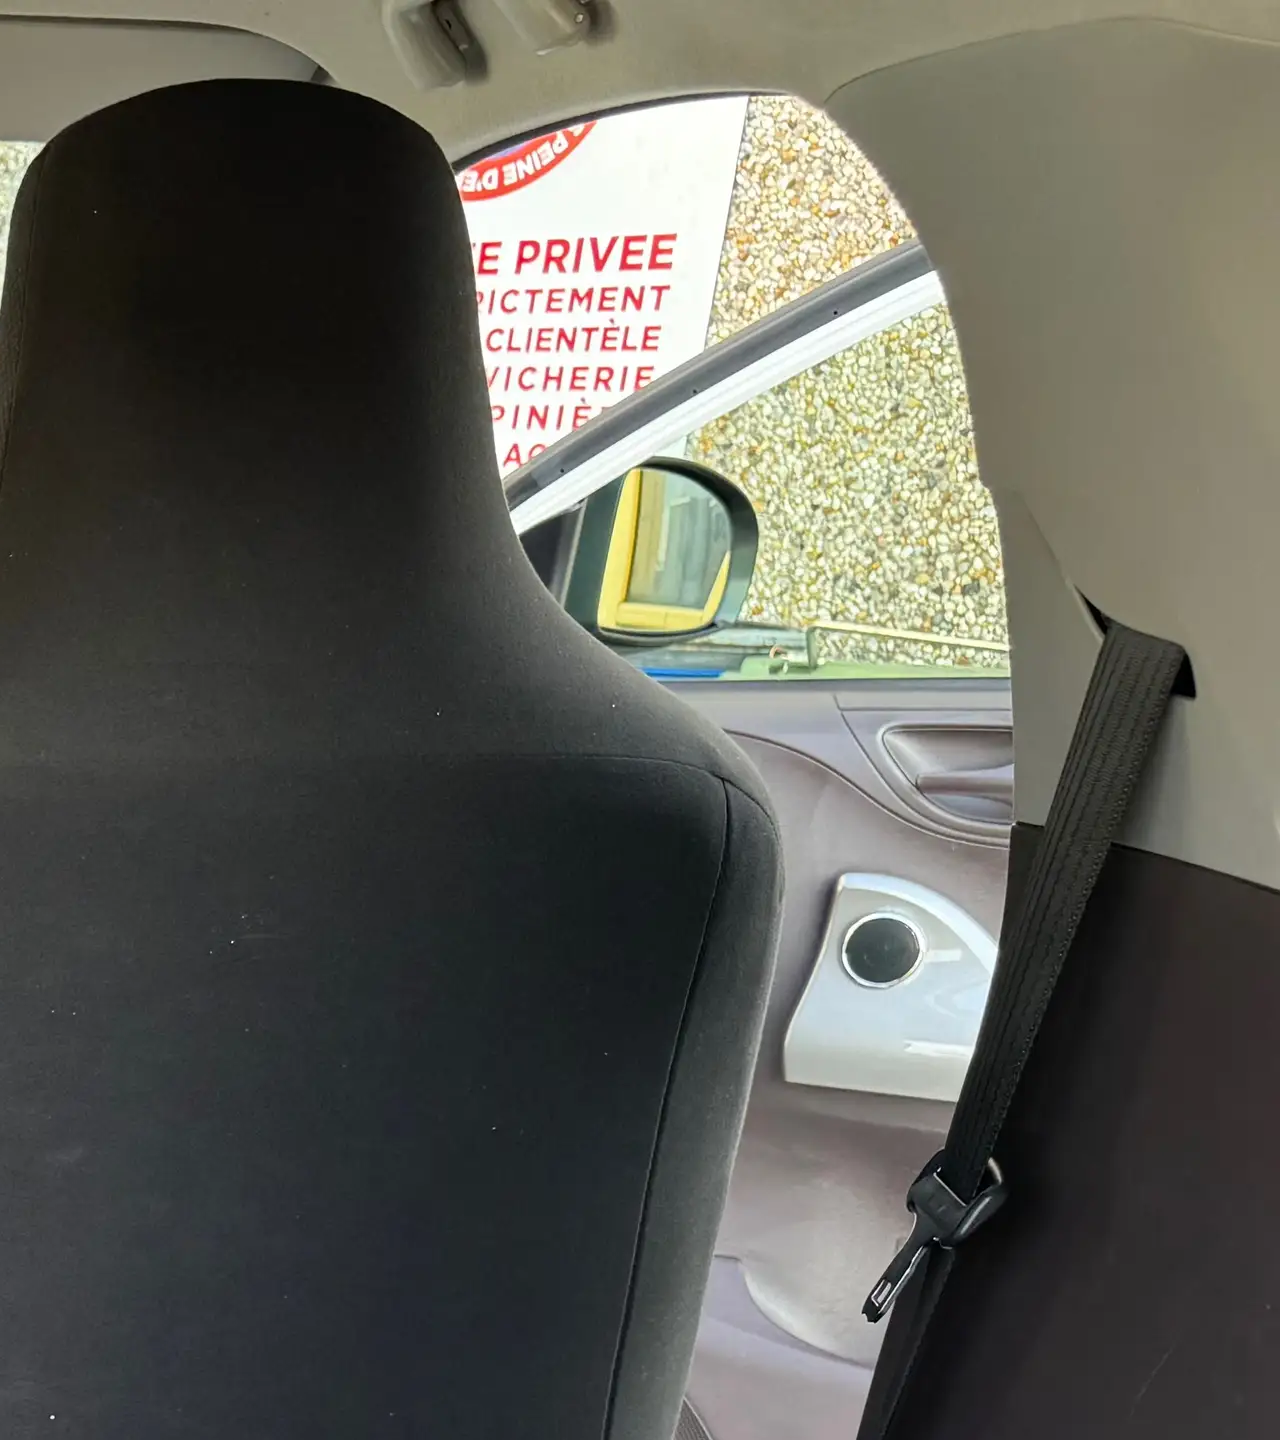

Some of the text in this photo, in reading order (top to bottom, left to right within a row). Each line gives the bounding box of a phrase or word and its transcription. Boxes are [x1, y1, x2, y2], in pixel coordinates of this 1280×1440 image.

[502, 131, 569, 186] PEINE
[514, 233, 678, 275] PRIVEE
[485, 318, 662, 352] CLIENTÈLE
